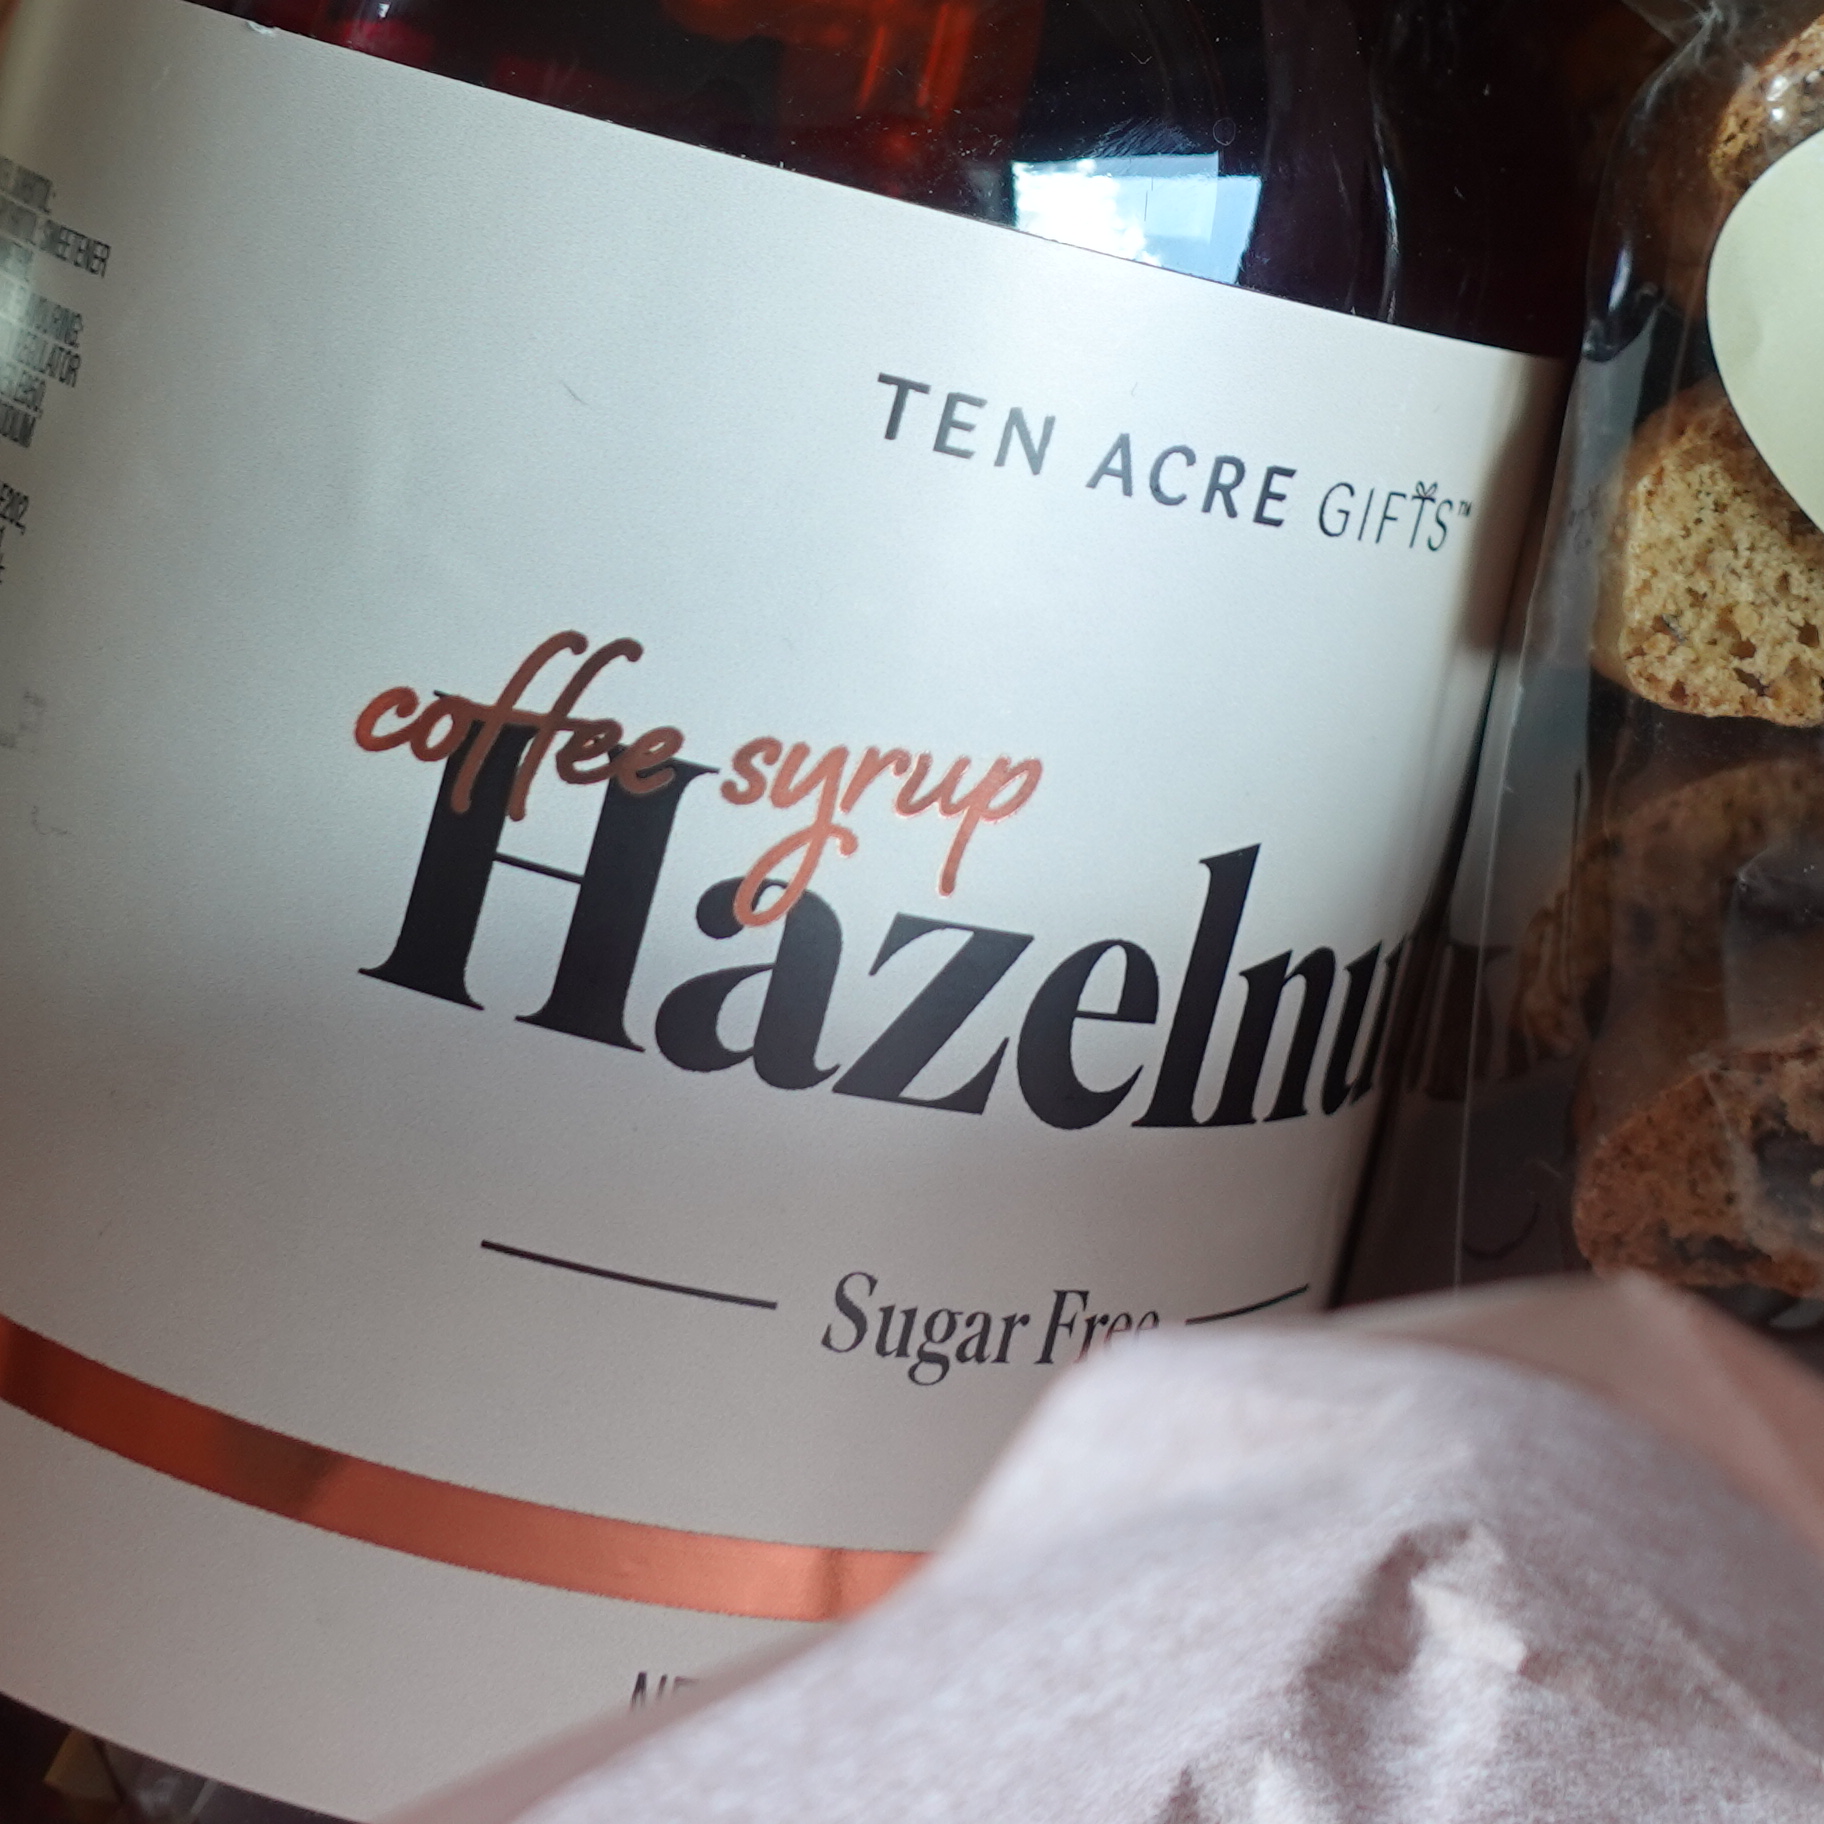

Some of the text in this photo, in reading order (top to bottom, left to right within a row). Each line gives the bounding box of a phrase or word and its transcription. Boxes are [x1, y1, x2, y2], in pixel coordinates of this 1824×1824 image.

[878, 372, 1056, 476] TEN
[1086, 432, 1298, 528] ACRE
[354, 629, 1044, 928] coffee syrup
[821, 1270, 1032, 1386] Sugar
